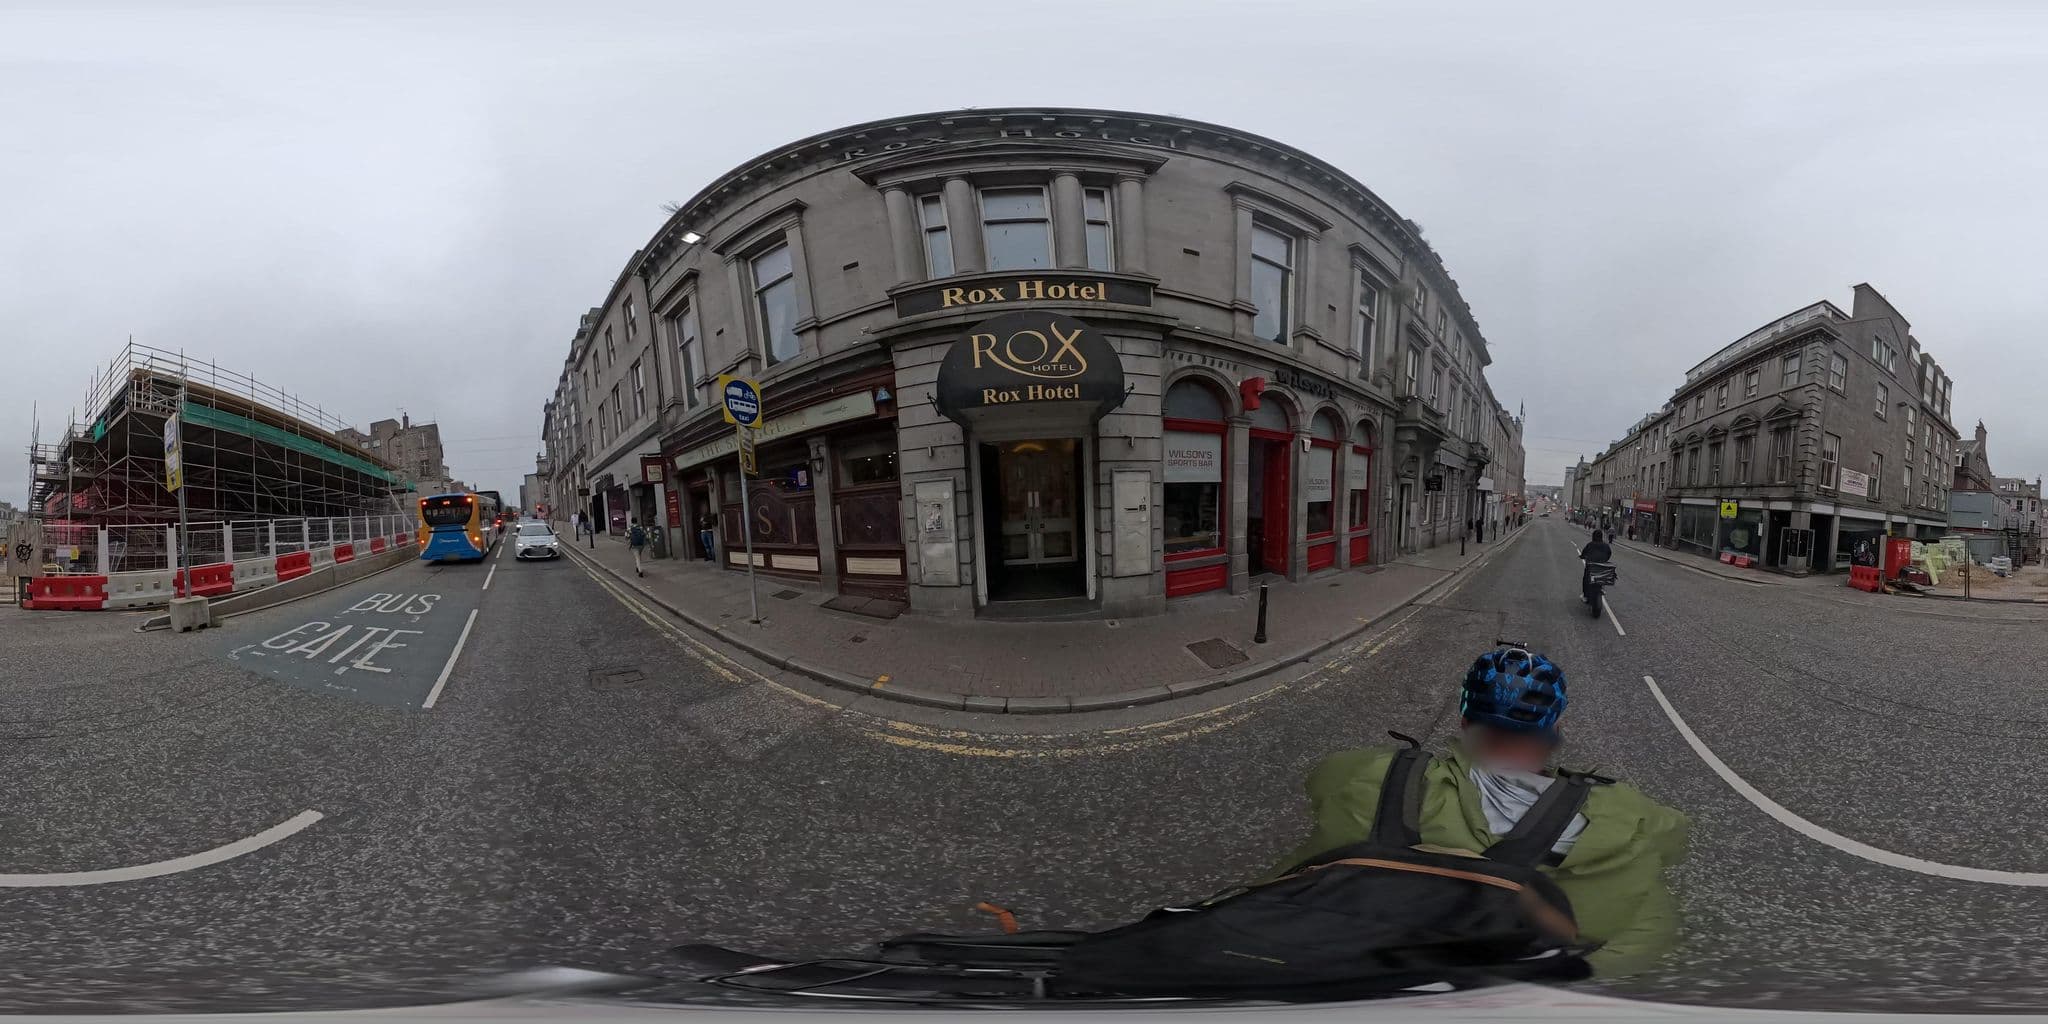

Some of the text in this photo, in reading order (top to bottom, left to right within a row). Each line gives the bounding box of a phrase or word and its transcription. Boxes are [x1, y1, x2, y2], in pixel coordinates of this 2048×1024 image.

[941, 280, 1107, 307] Rox Hotel
[971, 321, 1087, 378] ROX
[982, 383, 1080, 404] Rox Hotel
[1167, 459, 1197, 467] SPORTS
[1168, 449, 1213, 459] WILSON'S
[758, 505, 773, 535] S
[349, 593, 442, 615] BUS
[261, 621, 424, 674] GATE
